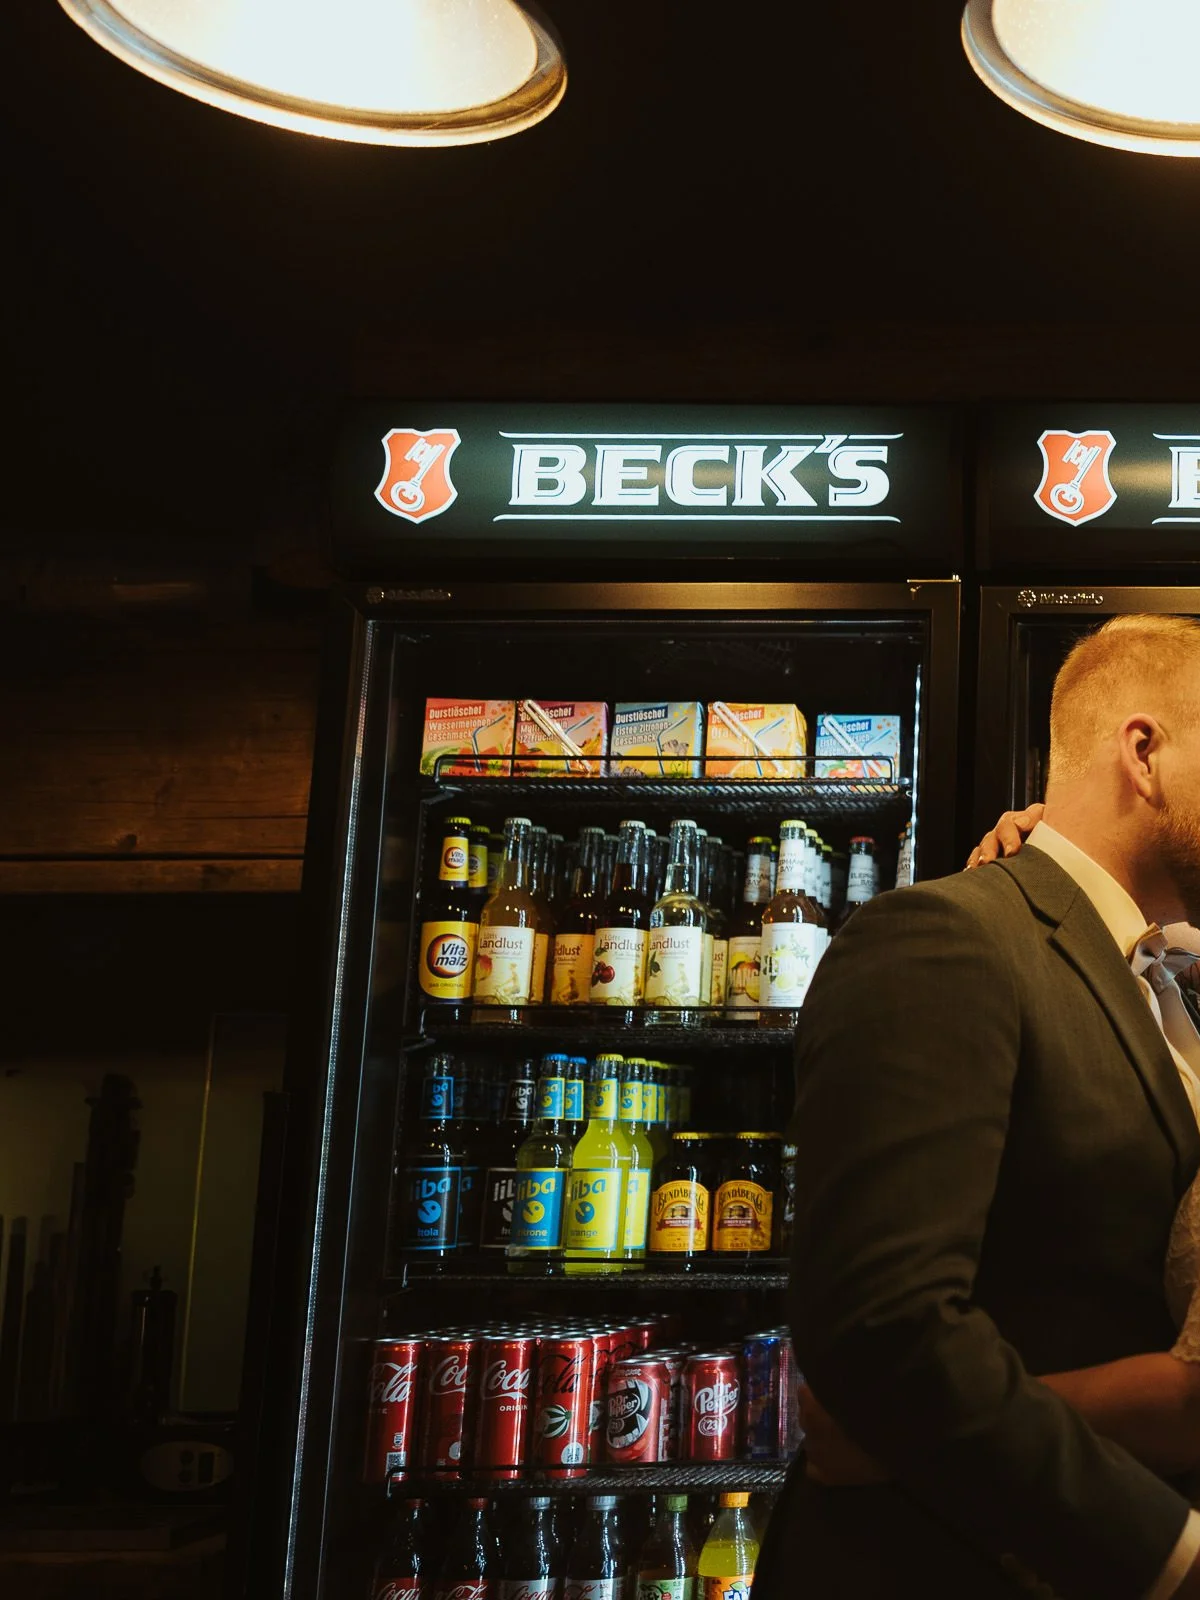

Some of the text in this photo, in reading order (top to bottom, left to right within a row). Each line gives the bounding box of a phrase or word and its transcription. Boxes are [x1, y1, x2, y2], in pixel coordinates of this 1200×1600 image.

[508, 434, 890, 507] BECK'S
[429, 705, 482, 719] Durstlöscher
[615, 707, 666, 723] Durstlöscher
[441, 943, 466, 955] Vita
[480, 937, 523, 949] Landlust
[435, 956, 467, 967] malz
